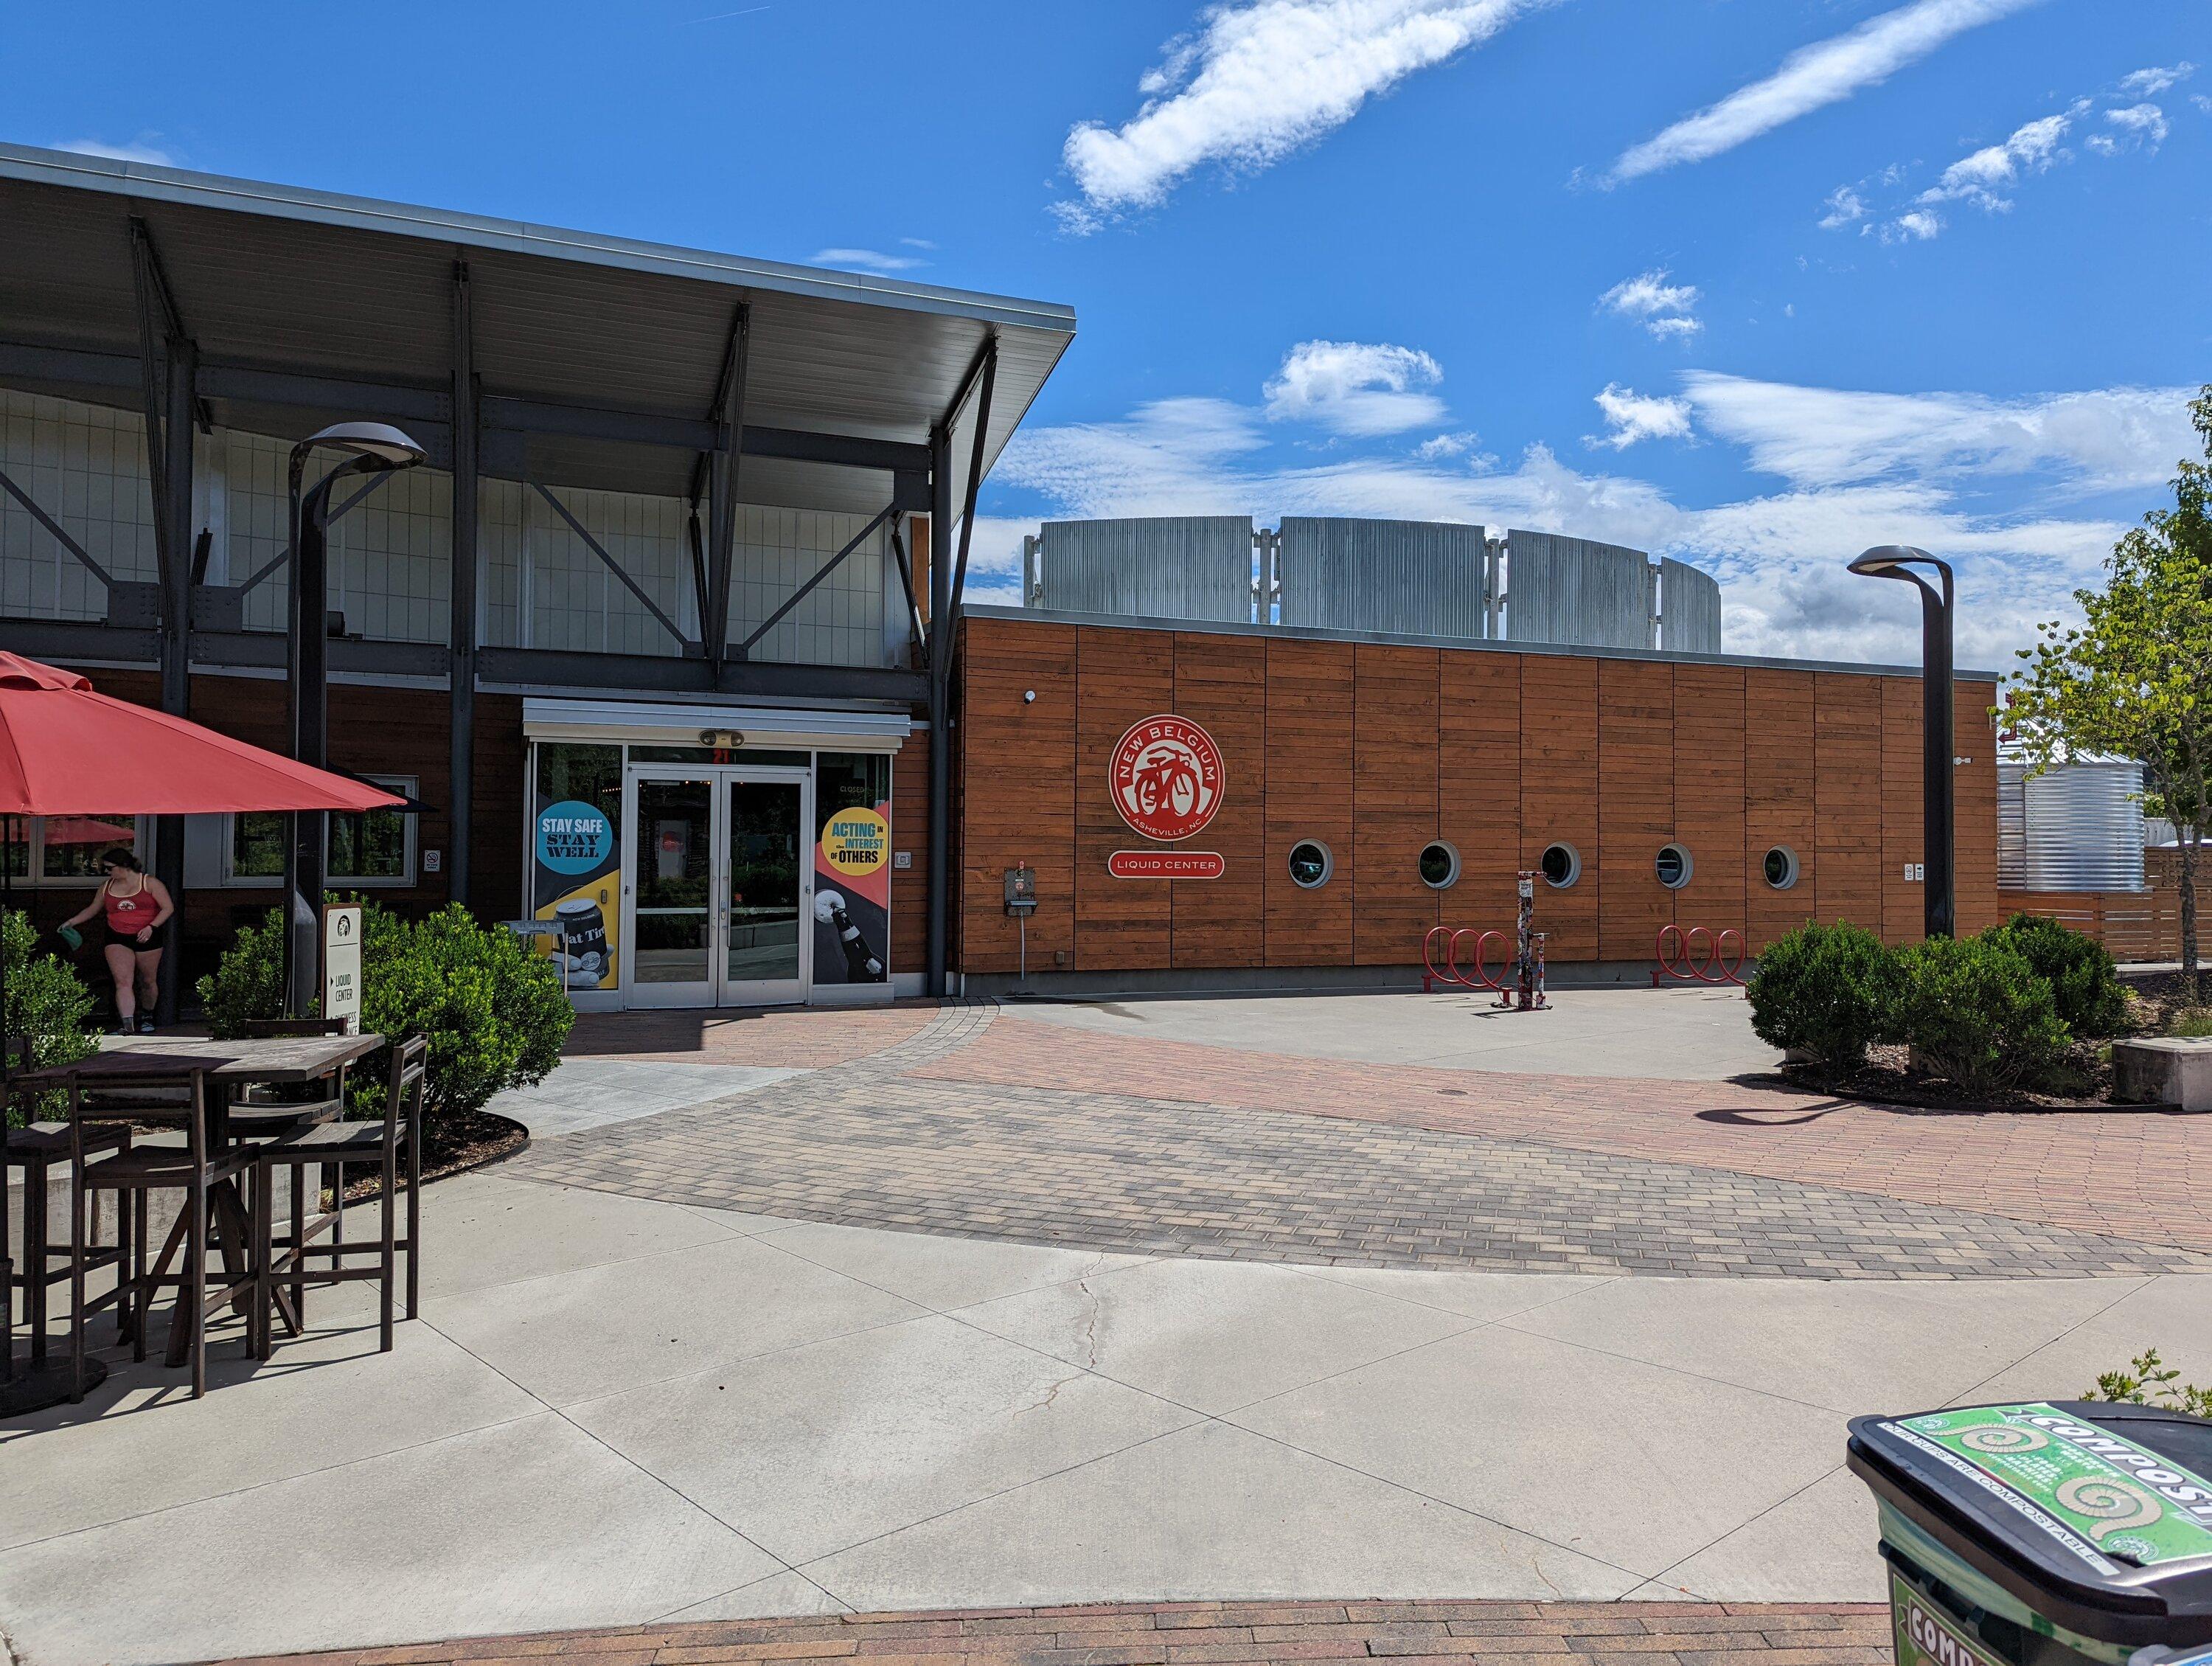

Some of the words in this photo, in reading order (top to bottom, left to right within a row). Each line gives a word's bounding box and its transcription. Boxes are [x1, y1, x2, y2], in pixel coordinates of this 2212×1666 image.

[713, 749, 729, 764] 21
[1120, 735, 1144, 778] NEW
[1149, 726, 1215, 780] BELGIUM
[542, 818, 573, 833] STAY
[574, 819, 602, 833] SAFE
[831, 822, 876, 838] ACTING
[1133, 818, 1189, 836] ASHEVILLE,
[1189, 818, 1202, 830] NC
[546, 834, 599, 845] STAY
[845, 839, 884, 849] INTEREST
[546, 847, 599, 858] WELL
[830, 852, 838, 860] OF
[838, 850, 878, 864] OTHERS
[1117, 860, 1161, 870] LIQUID
[1164, 861, 1216, 870] CENTER
[335, 973, 351, 987] LIQUID
[335, 988, 352, 1002] CENTER
[1885, 1424, 1912, 1438] OUR
[1912, 1438, 1949, 1458] CUPS
[1947, 1460, 1980, 1476] ARE
[1980, 1478, 2102, 1563] COMPOSTABLE
